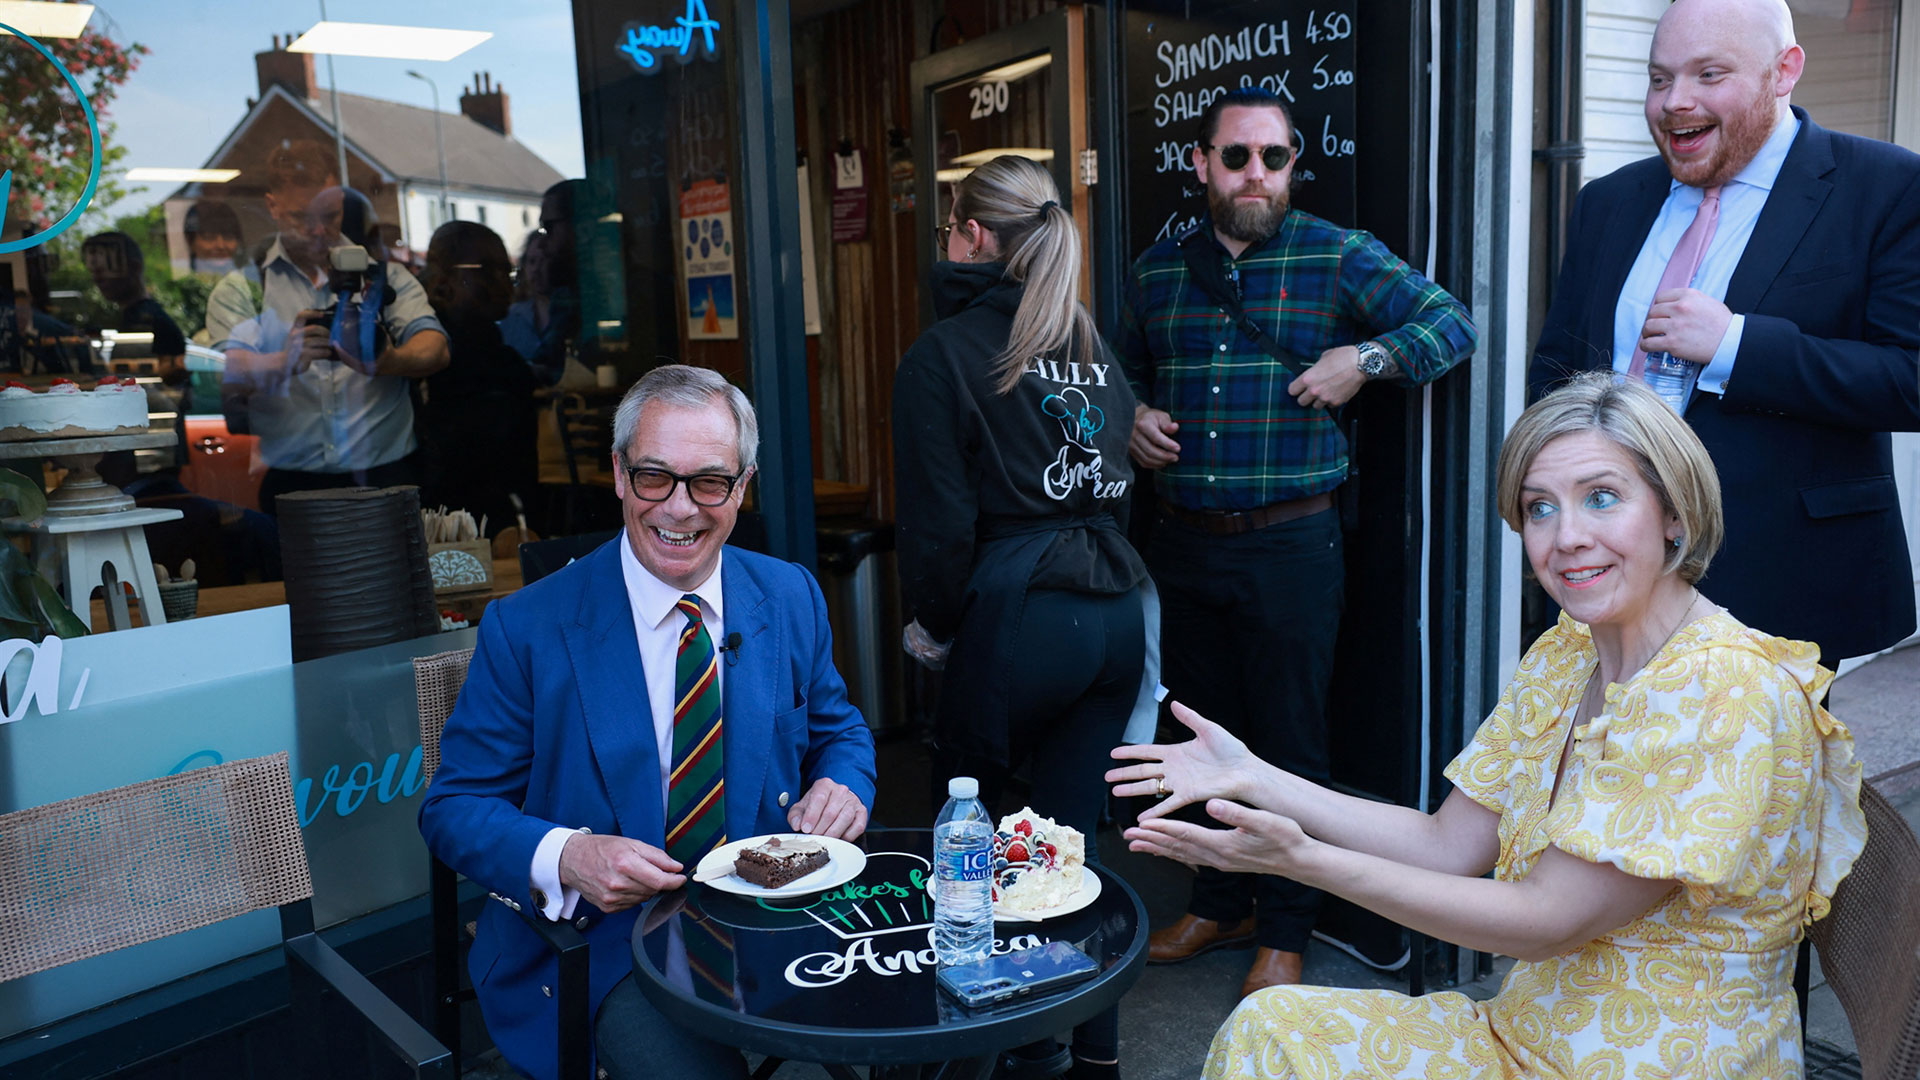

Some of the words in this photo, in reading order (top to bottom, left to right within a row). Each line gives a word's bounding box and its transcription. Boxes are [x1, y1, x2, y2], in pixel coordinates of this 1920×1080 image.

[1155, 20, 1291, 88] SANDWICH
[1305, 10, 1351, 45] 4.50
[1312, 54, 1354, 91] 5.00
[969, 79, 1010, 120] 290
[1322, 115, 1355, 157] 6.00
[962, 867, 993, 881] VALLE
[963, 848, 994, 871] ICE
[784, 928, 1051, 989] Andea
